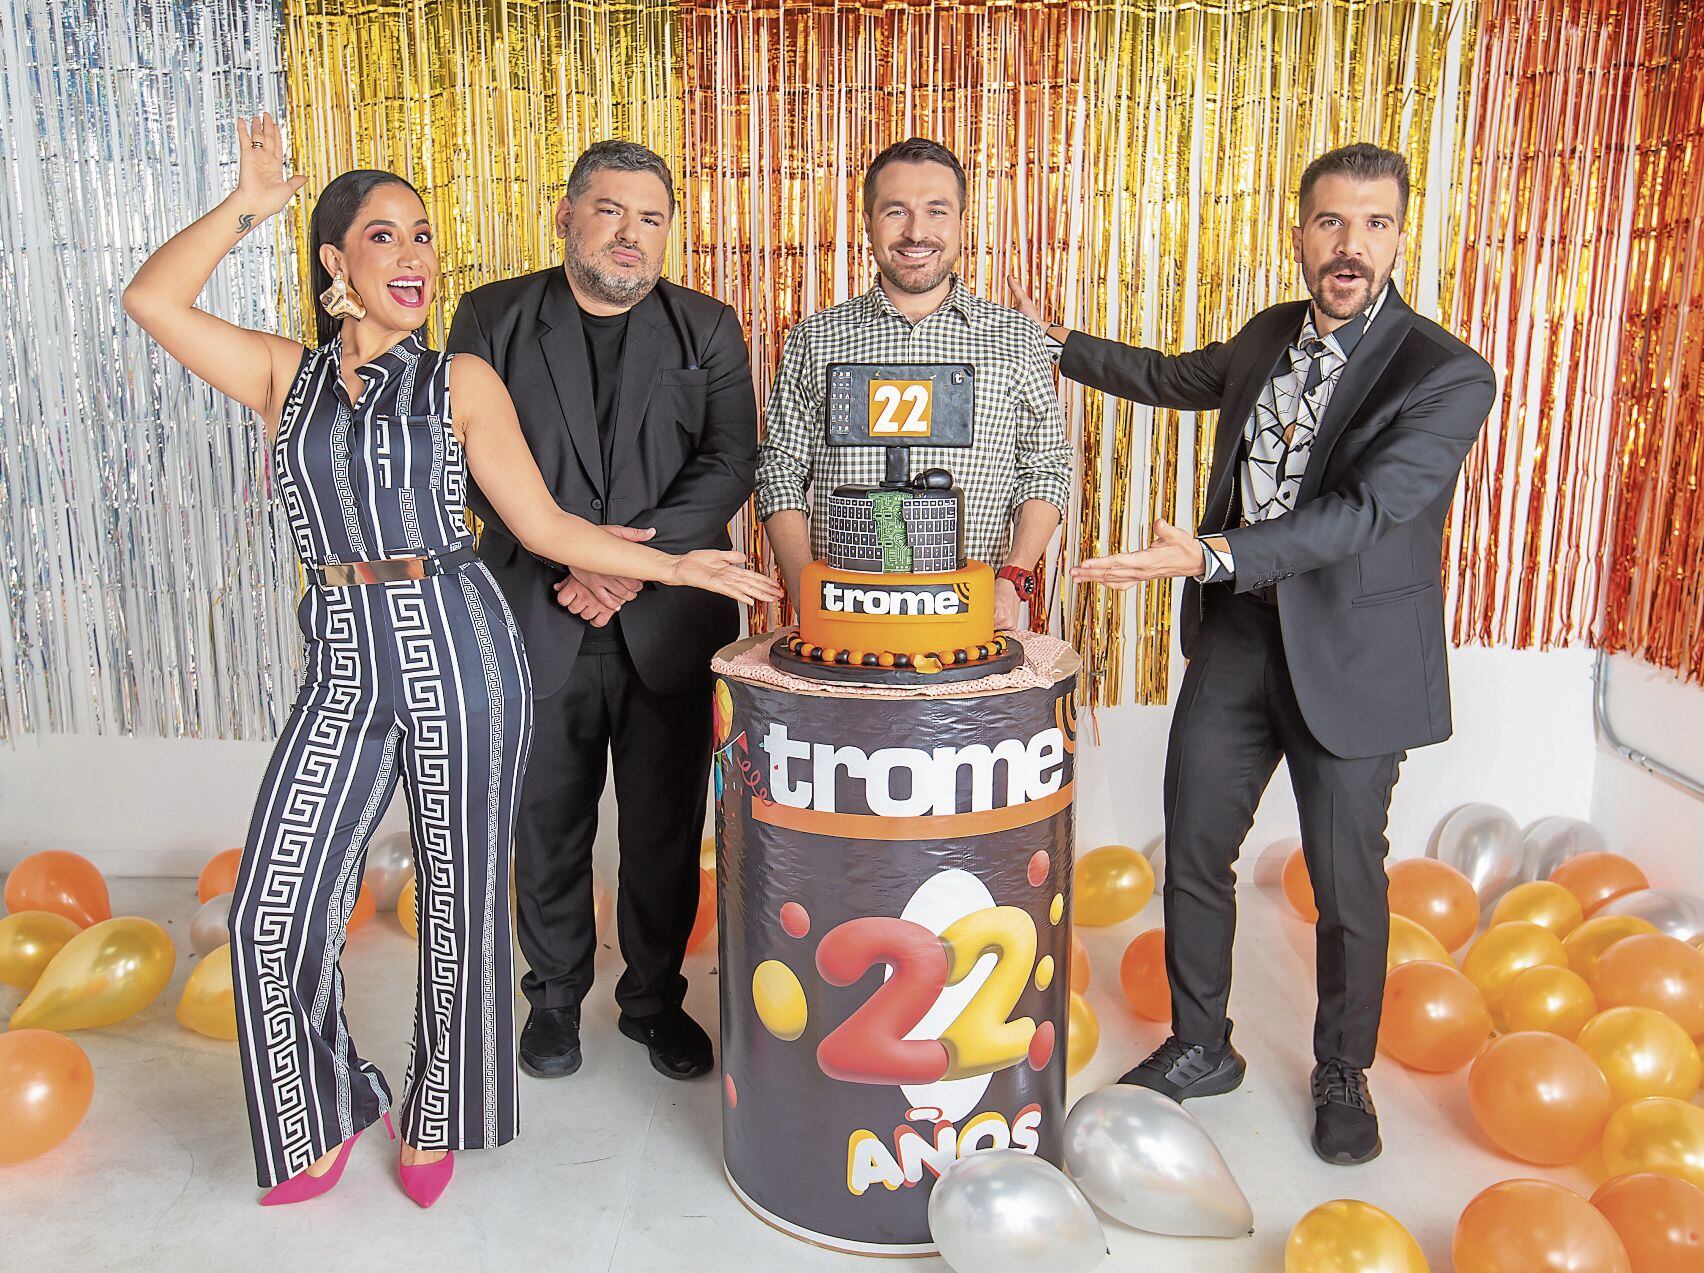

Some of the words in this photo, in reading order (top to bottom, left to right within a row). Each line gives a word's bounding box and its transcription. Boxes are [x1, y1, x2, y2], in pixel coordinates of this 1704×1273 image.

[872, 384, 929, 433] 22
[823, 582, 960, 616] trome
[763, 722, 1064, 818] trome
[815, 905, 1038, 1086] 22
[847, 1102, 1042, 1196] AÑOS
